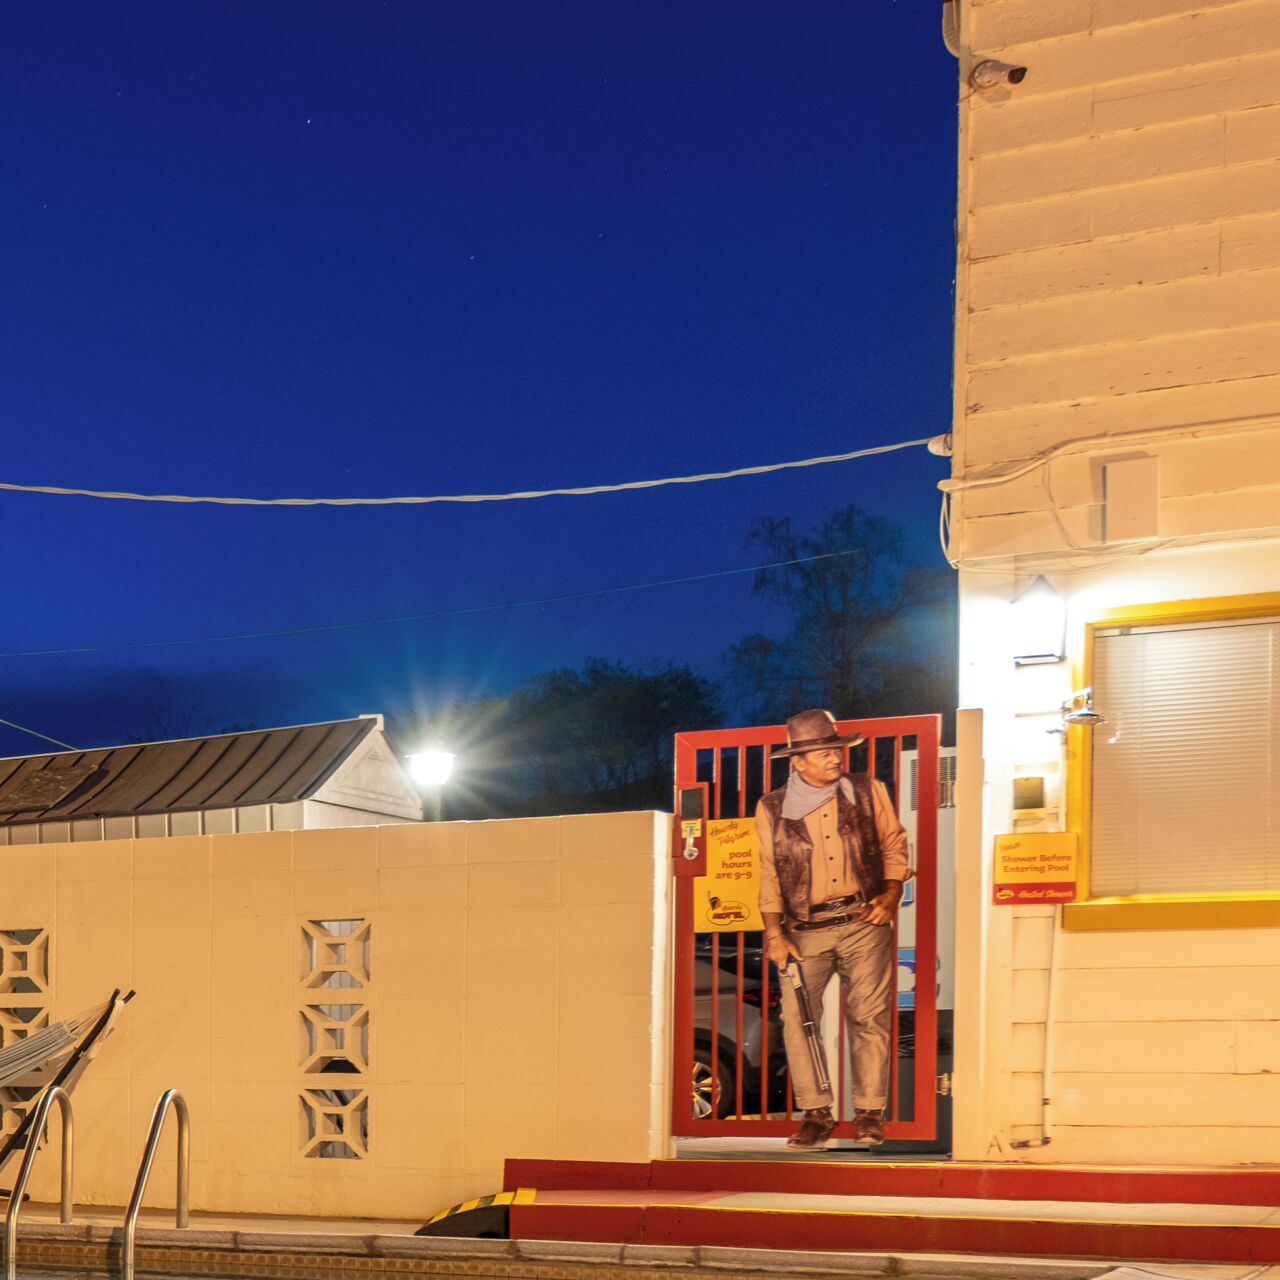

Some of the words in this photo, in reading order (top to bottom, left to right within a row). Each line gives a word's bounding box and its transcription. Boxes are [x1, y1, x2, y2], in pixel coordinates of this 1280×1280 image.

[729, 850, 752, 860] pool
[722, 860, 752, 868] hours
[1003, 865, 1045, 873] Entering
